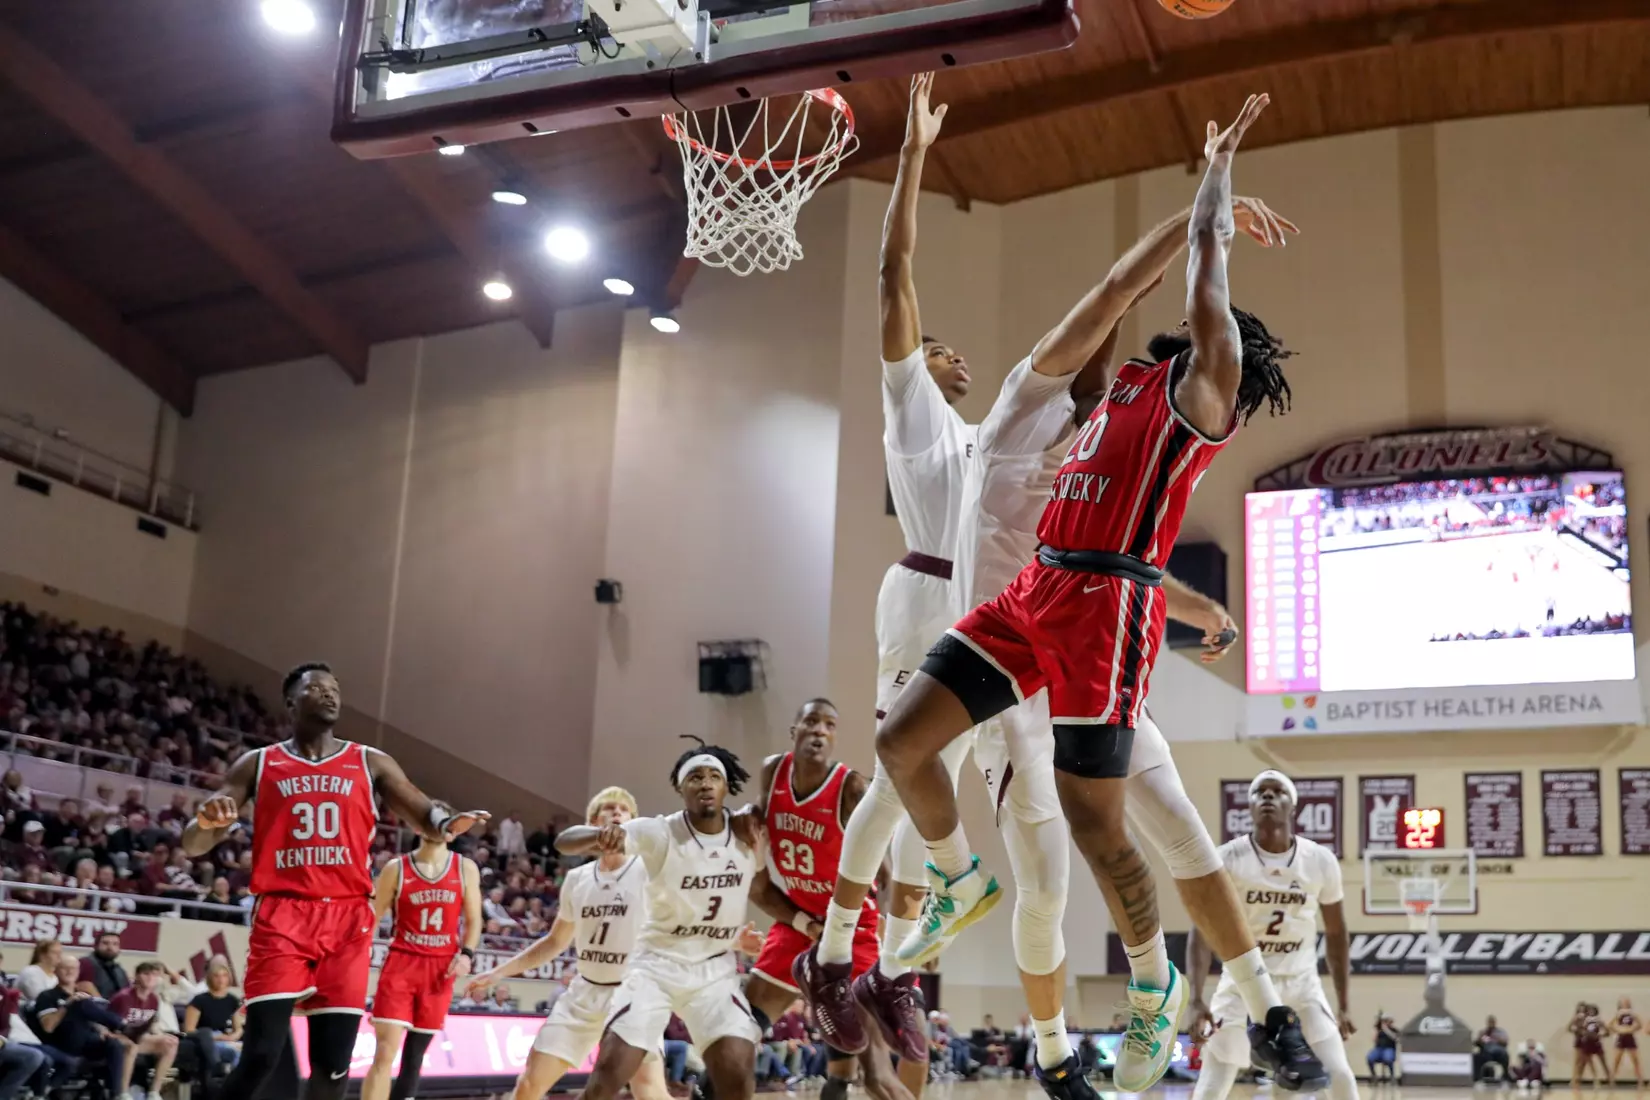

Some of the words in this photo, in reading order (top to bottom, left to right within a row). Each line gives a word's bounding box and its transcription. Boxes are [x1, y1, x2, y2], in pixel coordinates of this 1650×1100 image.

[1061, 411, 1110, 467] 20
[1304, 437, 1553, 488] COLONELS
[1325, 699, 1417, 722] BAPTIST
[1423, 695, 1514, 718] HEALTH
[1521, 693, 1604, 715] ARENA
[276, 774, 354, 798] WESTERN
[291, 800, 340, 840] 30
[774, 812, 826, 842] WESTERN
[1225, 808, 1253, 834] 62
[1296, 802, 1333, 832] 40
[1405, 825, 1436, 849] 22
[778, 838, 815, 875] 33
[680, 873, 744, 890] EASTERN
[408, 888, 457, 906] WESTERN
[701, 895, 723, 921] 3
[1245, 890, 1307, 905] EASTERN
[419, 906, 444, 932] 14
[581, 904, 628, 919] EASTERN
[1265, 909, 1285, 936] 2
[0, 909, 128, 947] RSITY
[1349, 932, 1650, 961] VOLLEYBALL
